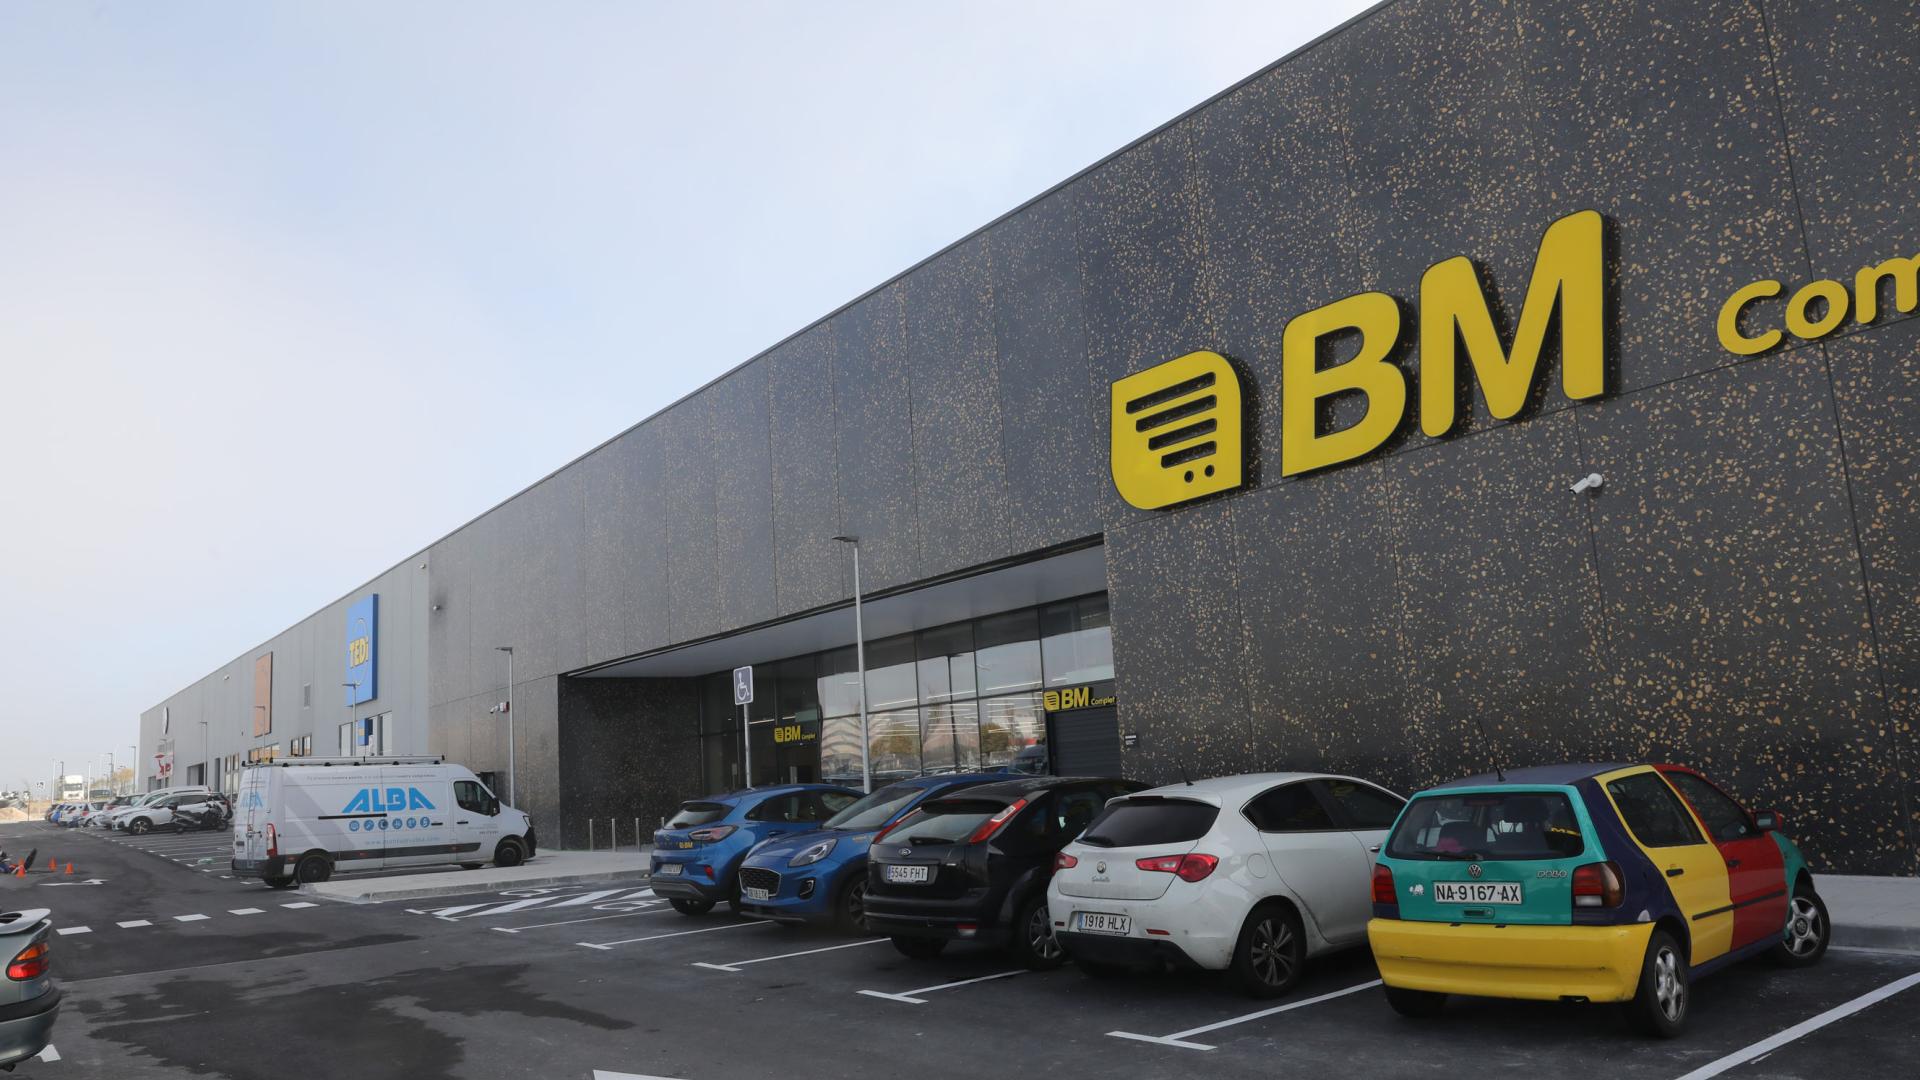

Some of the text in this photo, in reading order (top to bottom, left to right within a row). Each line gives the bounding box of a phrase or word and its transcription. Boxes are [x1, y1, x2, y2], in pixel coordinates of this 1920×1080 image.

[1281, 210, 1604, 478] BM
[1061, 687, 1089, 709] BM
[784, 725, 801, 742] BM
[342, 787, 436, 813] ALBA
[891, 867, 926, 879] 5545 FHT
[1085, 915, 1126, 931] 1918 HLX
